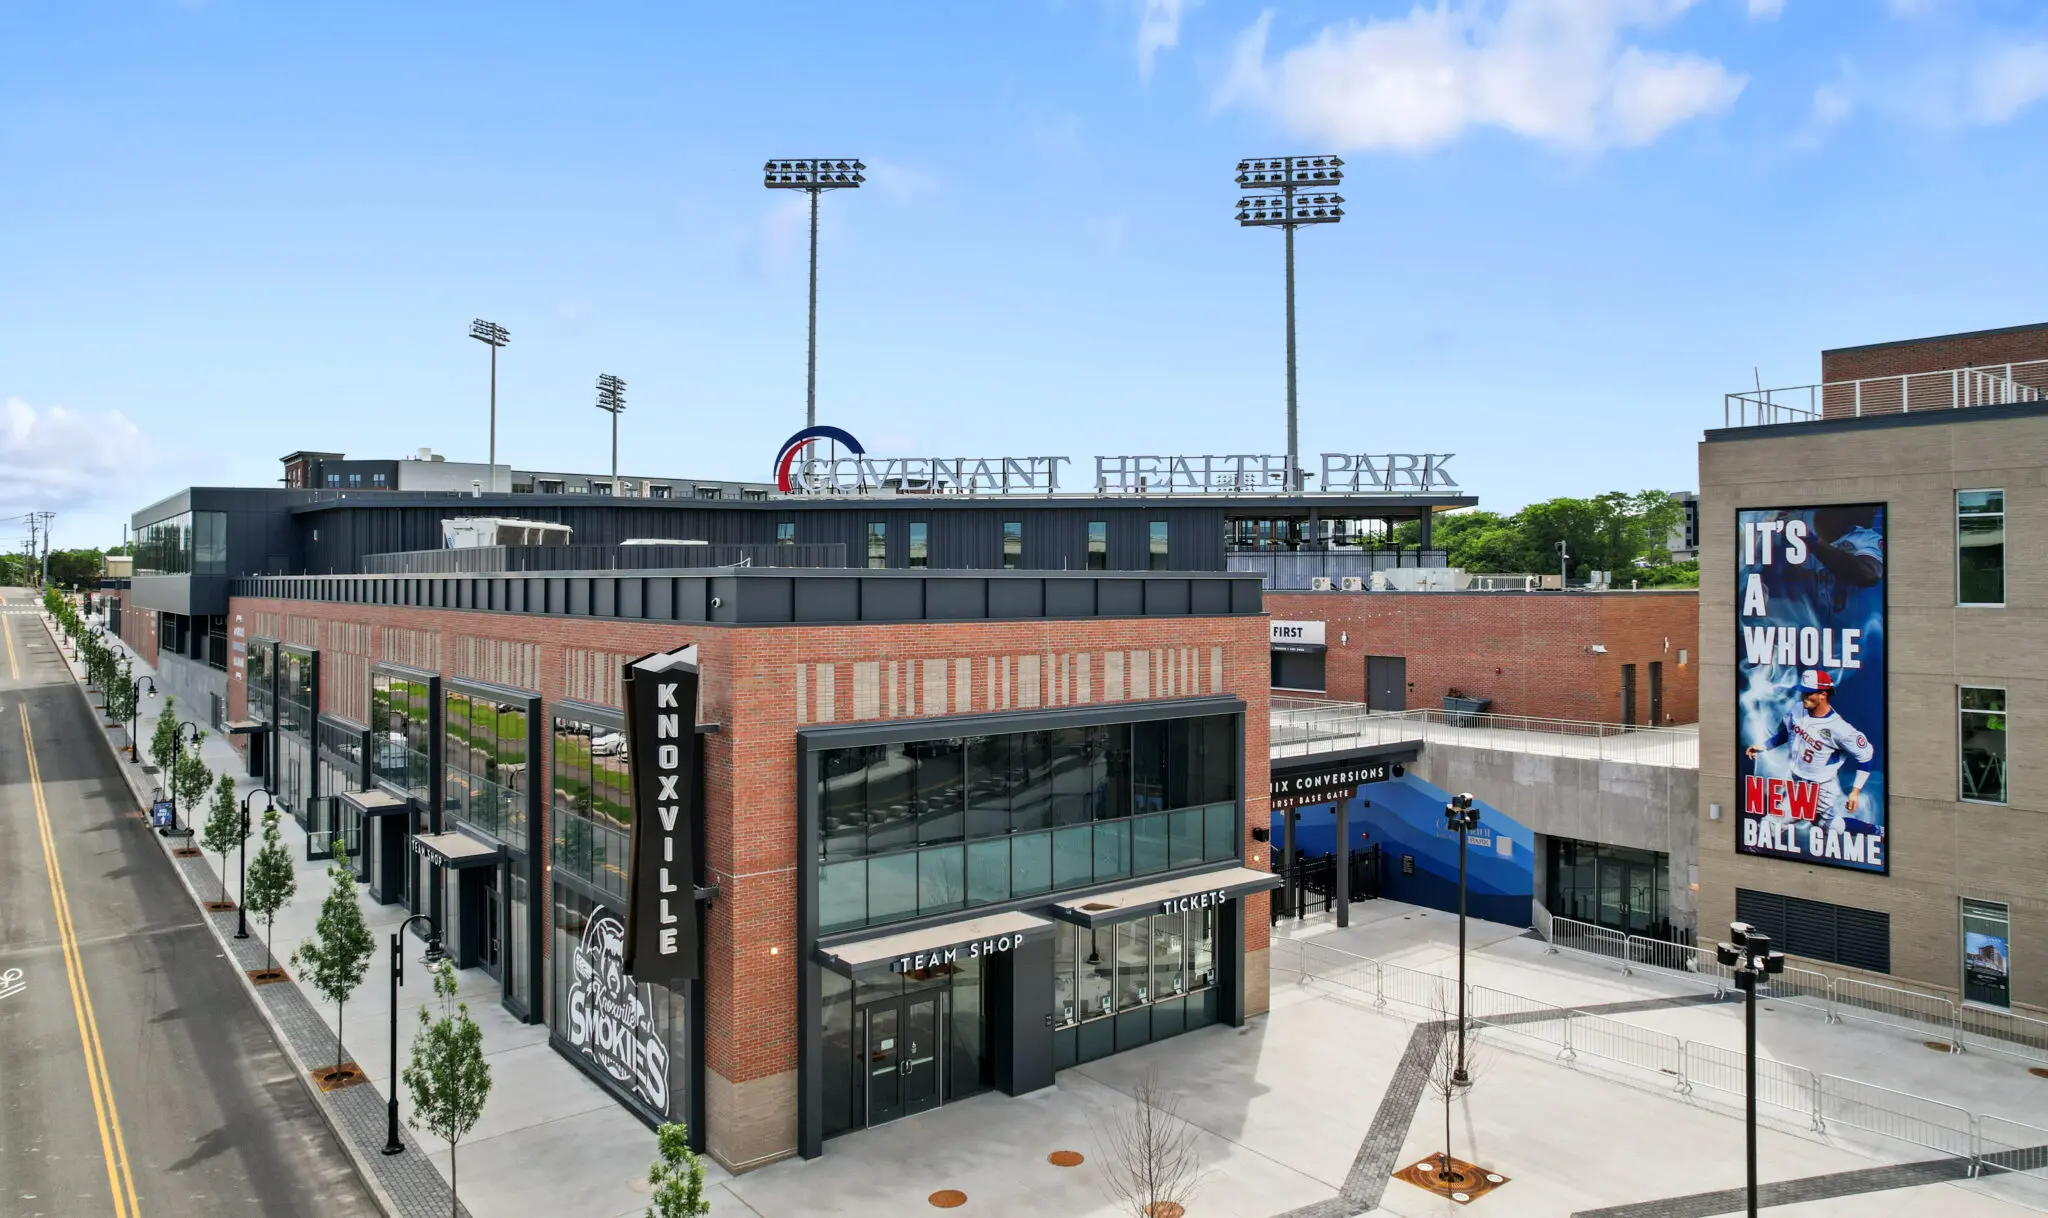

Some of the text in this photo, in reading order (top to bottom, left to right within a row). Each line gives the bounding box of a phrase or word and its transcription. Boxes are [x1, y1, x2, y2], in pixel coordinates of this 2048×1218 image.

[797, 453, 1459, 491] COVENANT HEALTH PARK
[1744, 519, 1808, 566] IT'S
[1742, 573, 1767, 617] A
[1273, 626, 1304, 638] FIRST
[1743, 626, 1862, 669] WHOLE
[1272, 789, 1349, 809] IRST BASE GATE
[1296, 767, 1385, 790] CONVERSIONS
[1745, 775, 1820, 822] NEW
[657, 683, 679, 955] KNOXVILLE
[411, 840, 442, 868] TEAM SHOP
[1744, 818, 1882, 866] BALL GAME
[1163, 889, 1226, 916] TICKETS
[901, 934, 1023, 973] TEAM SHOP
[592, 980, 637, 1030] Knoxville
[571, 990, 666, 1109] SMOKIES
